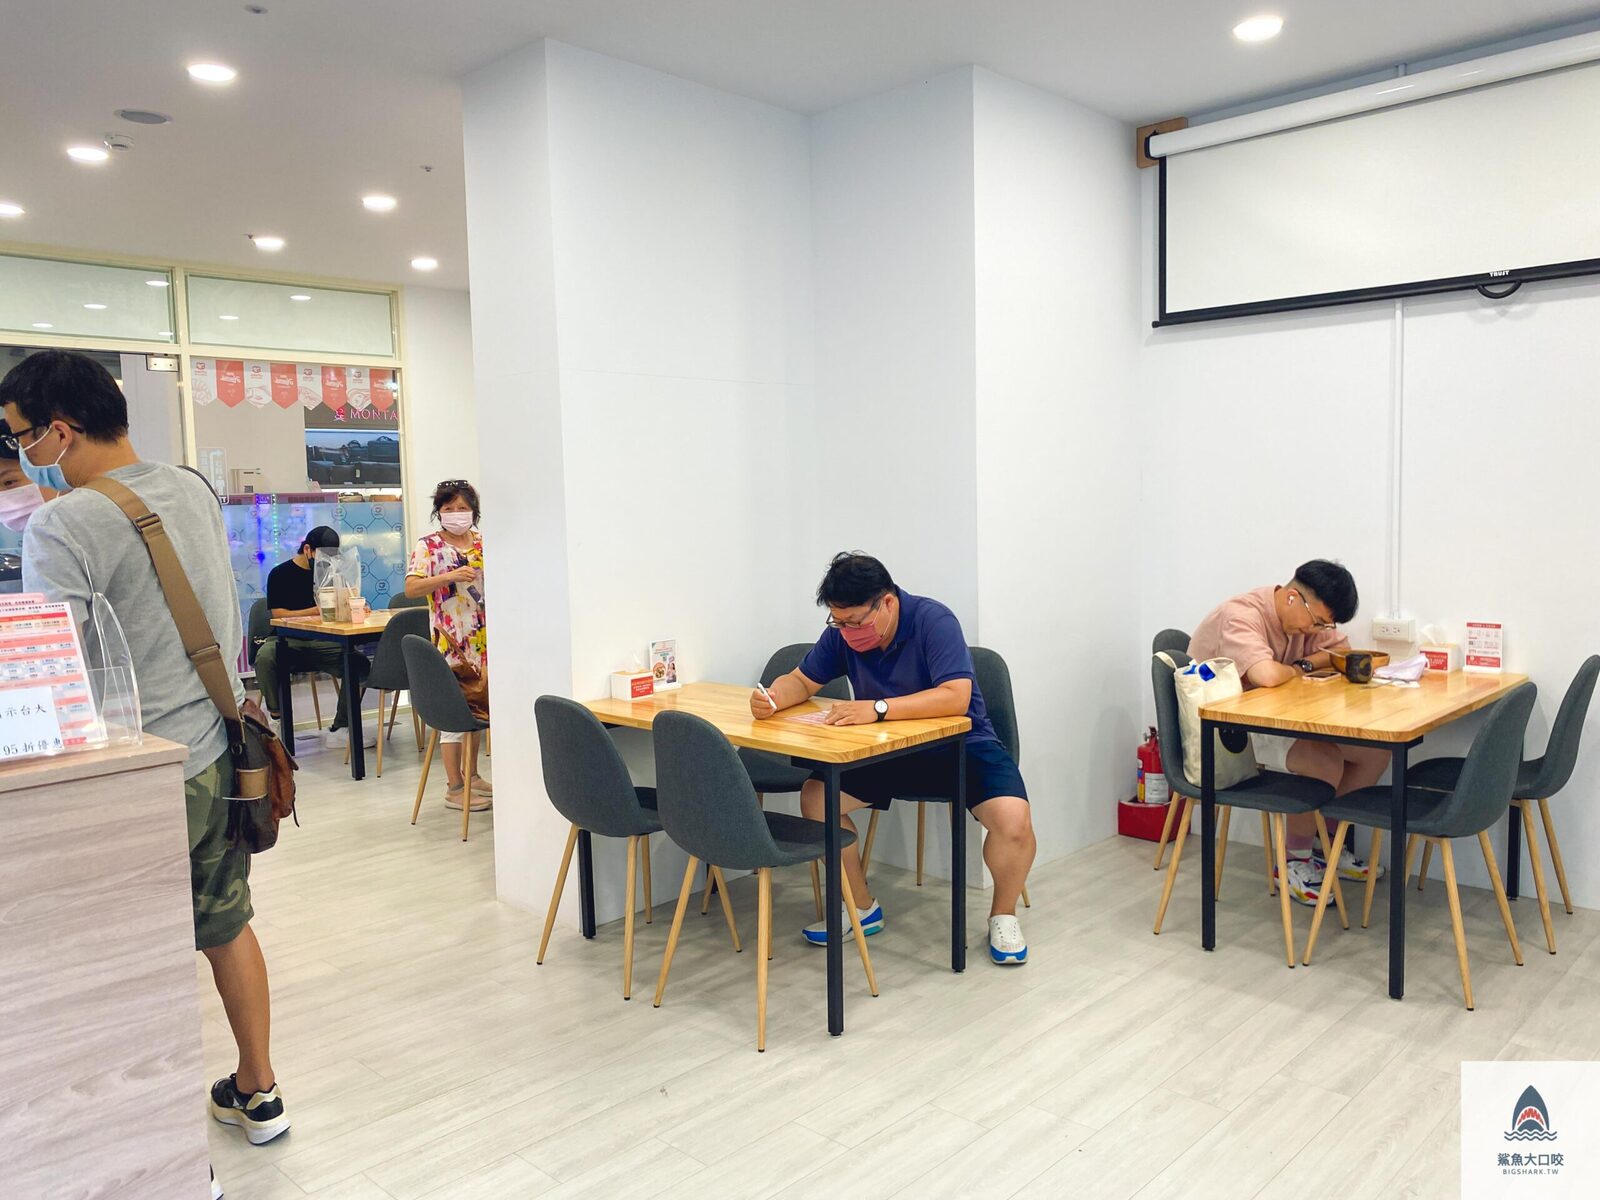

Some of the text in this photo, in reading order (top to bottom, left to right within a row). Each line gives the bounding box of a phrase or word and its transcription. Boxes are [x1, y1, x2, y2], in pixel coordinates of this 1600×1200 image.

[1489, 270, 1510, 278] TRUST
[0, 704, 47, 718] 示台大
